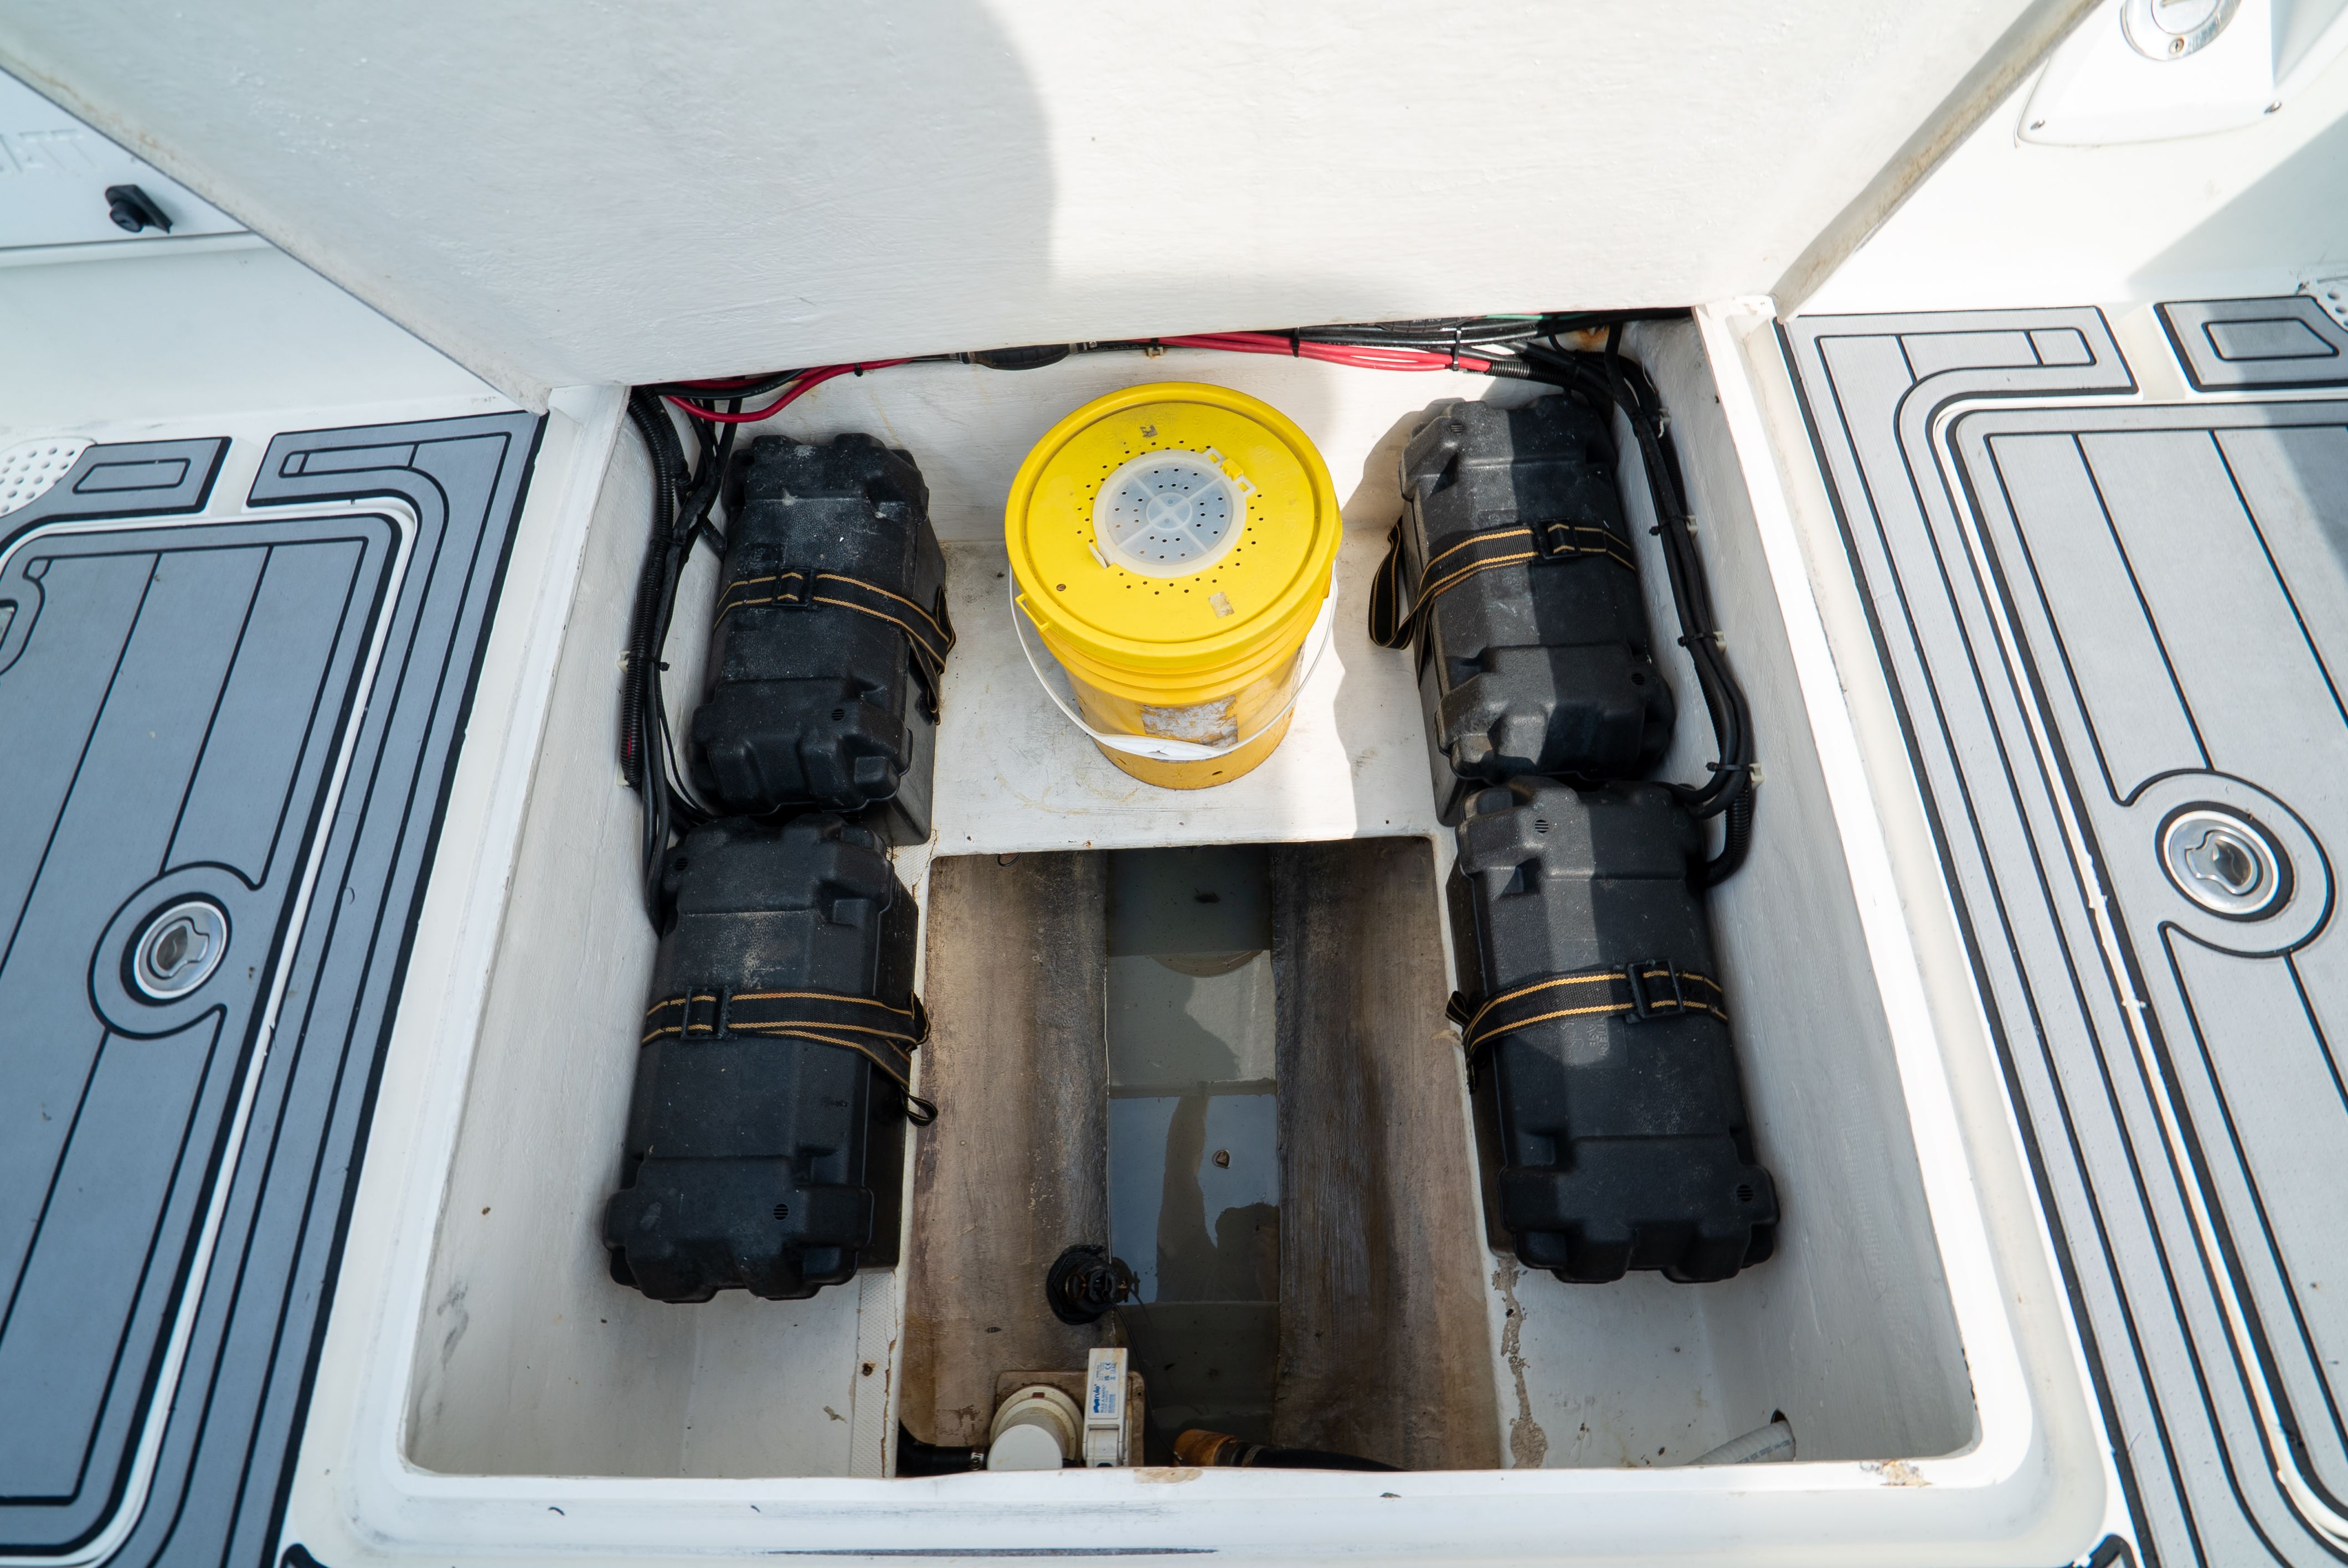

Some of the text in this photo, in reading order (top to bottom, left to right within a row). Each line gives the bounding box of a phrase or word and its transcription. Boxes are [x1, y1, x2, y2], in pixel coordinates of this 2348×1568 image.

[1130, 414, 1177, 433] MOST
[1191, 416, 1202, 427] 5
[1217, 421, 1276, 465] GALLON
[1273, 469, 1299, 533] PLASTIC
